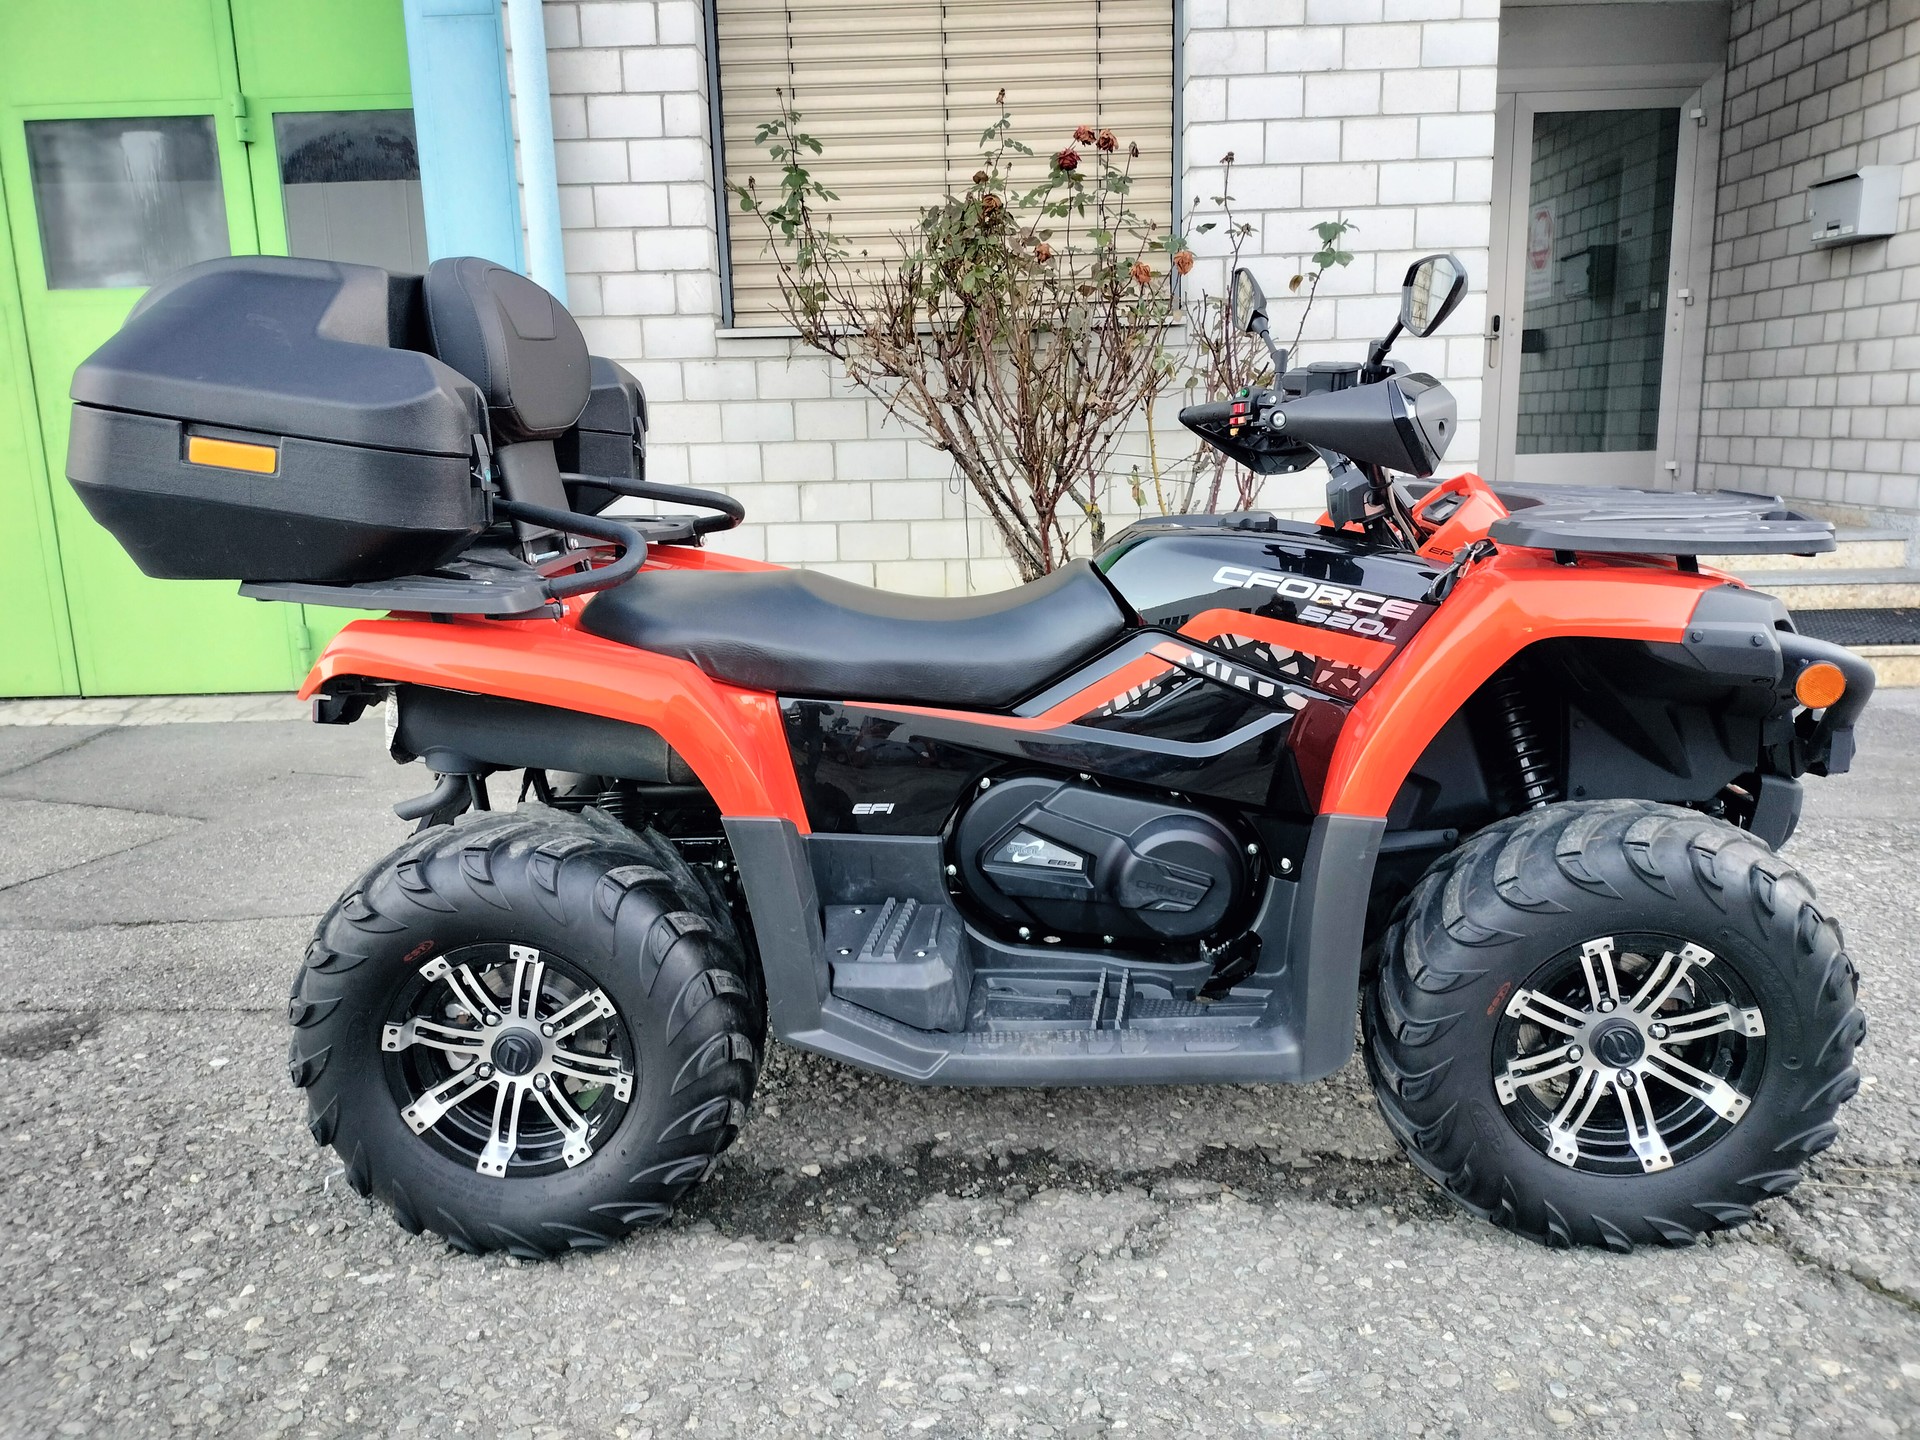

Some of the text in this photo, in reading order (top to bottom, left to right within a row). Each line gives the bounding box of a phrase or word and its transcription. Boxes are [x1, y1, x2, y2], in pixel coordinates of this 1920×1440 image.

[1428, 546, 1454, 559] EP
[1212, 566, 1419, 621] CFORCE
[1297, 605, 1397, 640] 520L
[852, 803, 895, 815] EFI
[1048, 859, 1078, 867] EBS
[1136, 880, 1199, 900] CFMOTO
